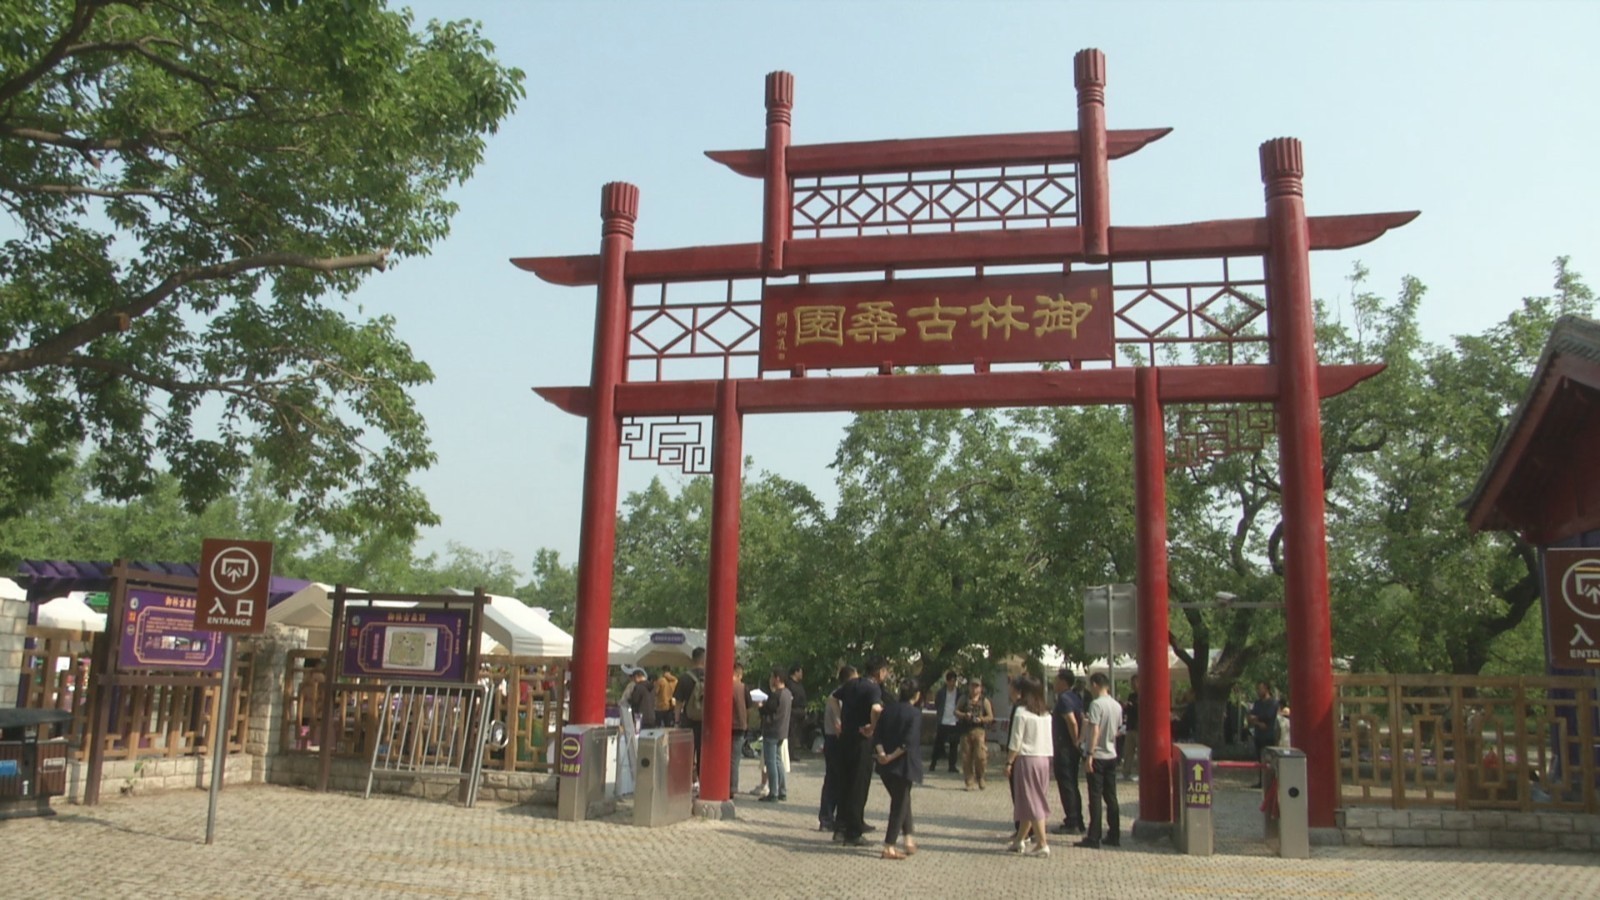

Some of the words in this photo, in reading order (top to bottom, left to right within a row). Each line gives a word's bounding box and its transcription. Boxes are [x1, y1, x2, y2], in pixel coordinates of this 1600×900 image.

[208, 597, 253, 616] 入口
[207, 616, 252, 626] ENTRANCE
[1569, 623, 1594, 646] 入
